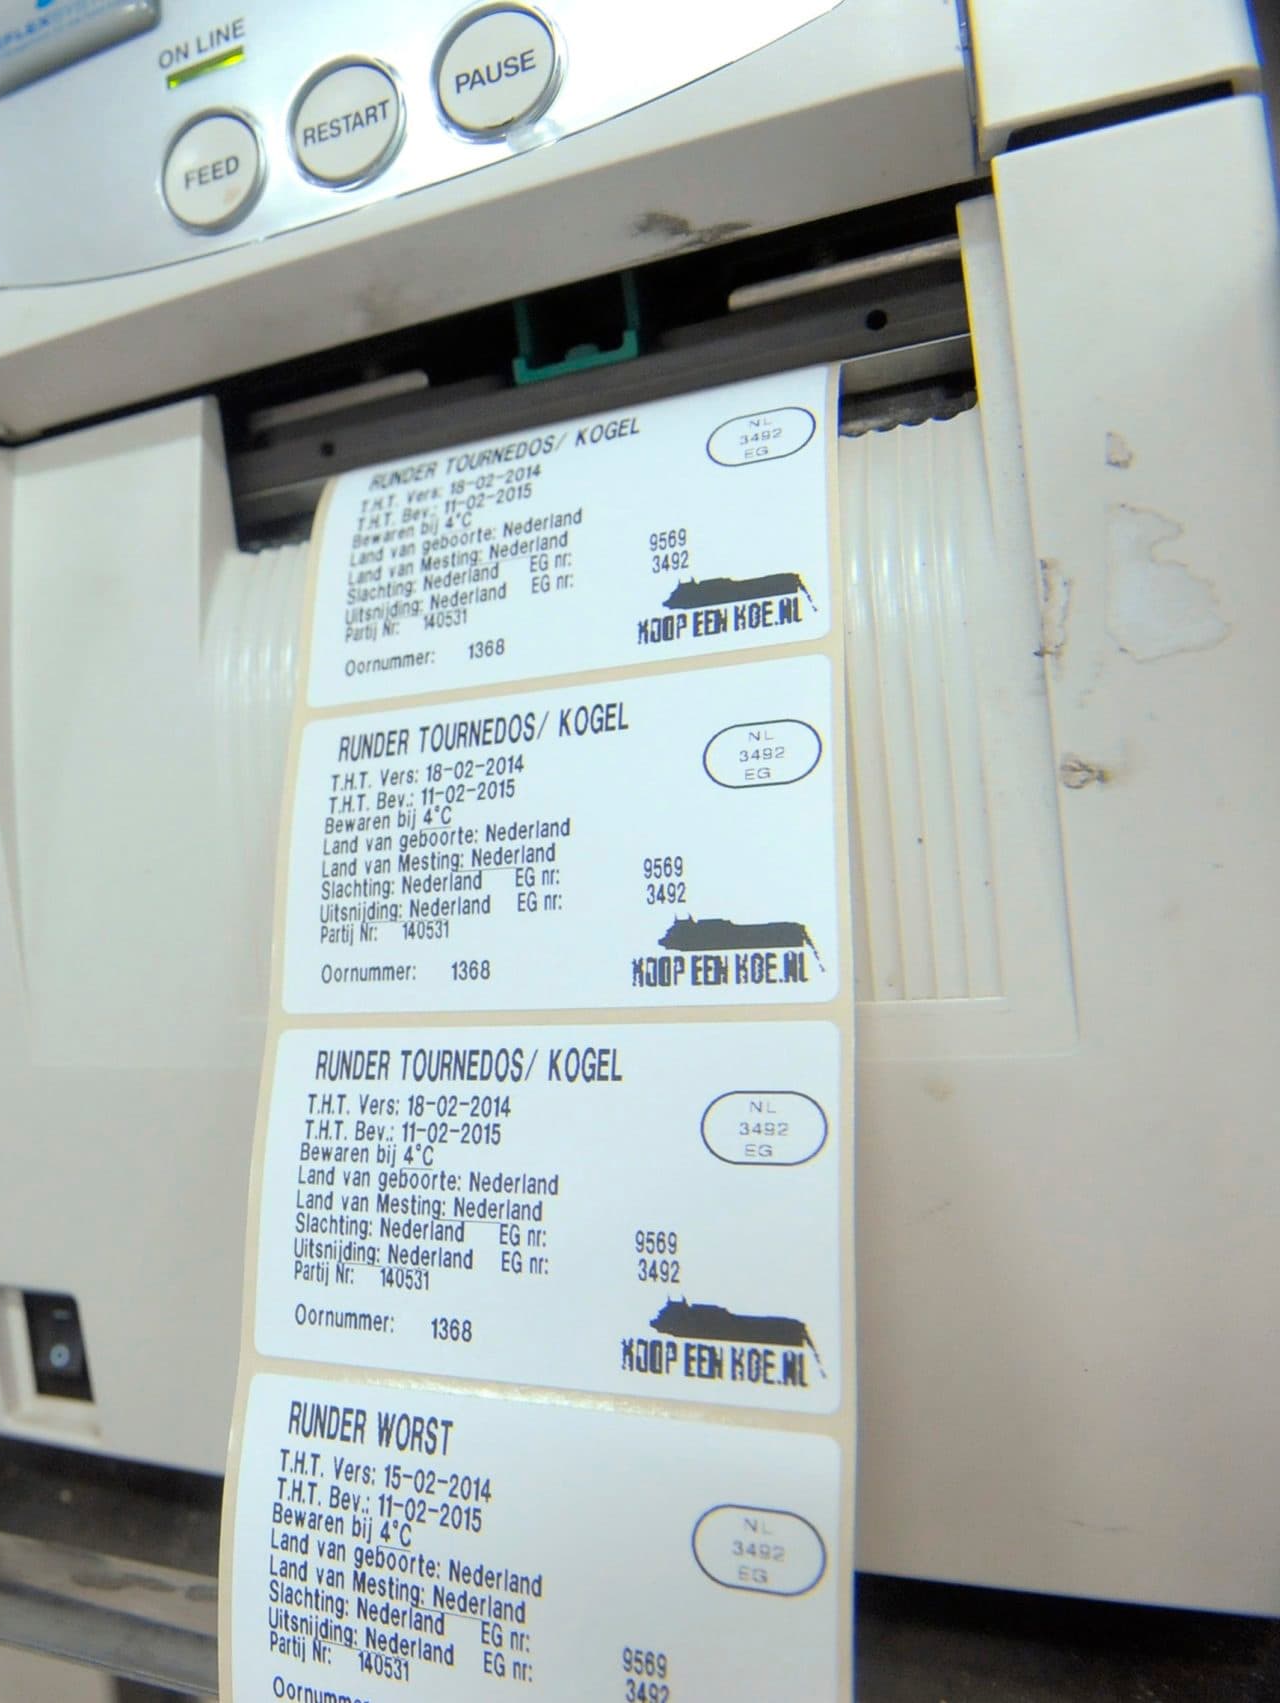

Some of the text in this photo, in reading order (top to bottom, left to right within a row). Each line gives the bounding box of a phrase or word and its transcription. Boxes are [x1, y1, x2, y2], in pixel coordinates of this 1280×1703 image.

[158, 18, 247, 71] ON LINE
[453, 48, 538, 96] PAUSE
[301, 99, 391, 148] RESTART
[182, 155, 241, 192] FEED
[575, 417, 640, 446] KOGEL
[740, 427, 782, 446] 3492
[749, 418, 771, 428] NL
[744, 445, 769, 459] EG
[450, 463, 541, 495] 18-02-2014
[444, 482, 532, 514] 11-02-2015
[422, 507, 583, 557] geboorte: Nederland
[420, 531, 569, 572] Mesting: Nederland
[423, 528, 687, 591] Nederland EG nr: 9569
[430, 550, 689, 610] Nederland EG nr: 3492
[423, 608, 467, 630] 140531
[344, 638, 505, 677] Oornummer: 1368
[338, 702, 629, 762] RUNDER TOURNEDOS/ KOGEL
[748, 730, 774, 742] NL
[739, 746, 785, 763] 3492
[331, 754, 524, 792] T.H.T. Vers: 18-02-2014
[744, 767, 771, 781] EG
[329, 793, 370, 815] T.H.T.
[421, 779, 515, 808] 11-02-2015
[323, 817, 571, 856] Land van geboorte: Nederland
[324, 815, 391, 835] Bewaren
[397, 809, 417, 831] bij
[321, 843, 556, 879] Land van Mesting: Nederland
[321, 856, 683, 901] Slachting: Nederland EG nr: 9569
[320, 881, 686, 924] Uitsnijding: Nederland EG nr: 3492
[320, 918, 449, 946] Partij Nr: 140531
[321, 959, 491, 984] Oornummer: 1368
[315, 1047, 623, 1083] RUNDER TOURNEDOS/ KOGEL
[308, 1093, 511, 1118] T.H.T. Vers: 18-02-2014
[749, 1100, 777, 1114] NL
[305, 1119, 348, 1141] T.H.T.
[402, 1121, 501, 1146] 11-02-2015
[739, 1121, 789, 1137] 3492
[300, 1141, 369, 1163] Bewaren
[376, 1143, 397, 1169] bij
[744, 1143, 773, 1158] EG
[297, 1165, 559, 1196] Land van geboorte: Nederland
[296, 1189, 543, 1223] Land van Mesting: Nederland
[295, 1211, 677, 1255] Slachting: Nederland EG nr: 9569
[293, 1237, 680, 1284] Uitsnijding: Nederland EG nr: 3492
[294, 1259, 429, 1291] Partij Nr: 140531
[294, 1303, 473, 1343] Oornummer: 1368
[288, 1400, 454, 1456] RUNDER WORST
[280, 1448, 492, 1503] T.H.T. Vers: 15-02-2014
[277, 1476, 321, 1506] T.H.T.
[378, 1493, 482, 1533] 11-02-2015
[272, 1502, 344, 1535] Bewaren
[351, 1514, 373, 1545] bij
[271, 1527, 543, 1598] Land van geboorte: Nederland
[732, 1540, 785, 1562] 3492
[269, 1554, 526, 1624] Land van Mesting: Nederland
[738, 1565, 769, 1584] EG
[268, 1607, 358, 1650] Uitsnijding:
[365, 1626, 454, 1666] Nederland
[483, 1650, 506, 1678] EG
[512, 1661, 533, 1683] nr:
[269, 1580, 667, 1679] Slachting: Nederland EG nr: 9569
[270, 1630, 409, 1682] Partij Nr: 140531
